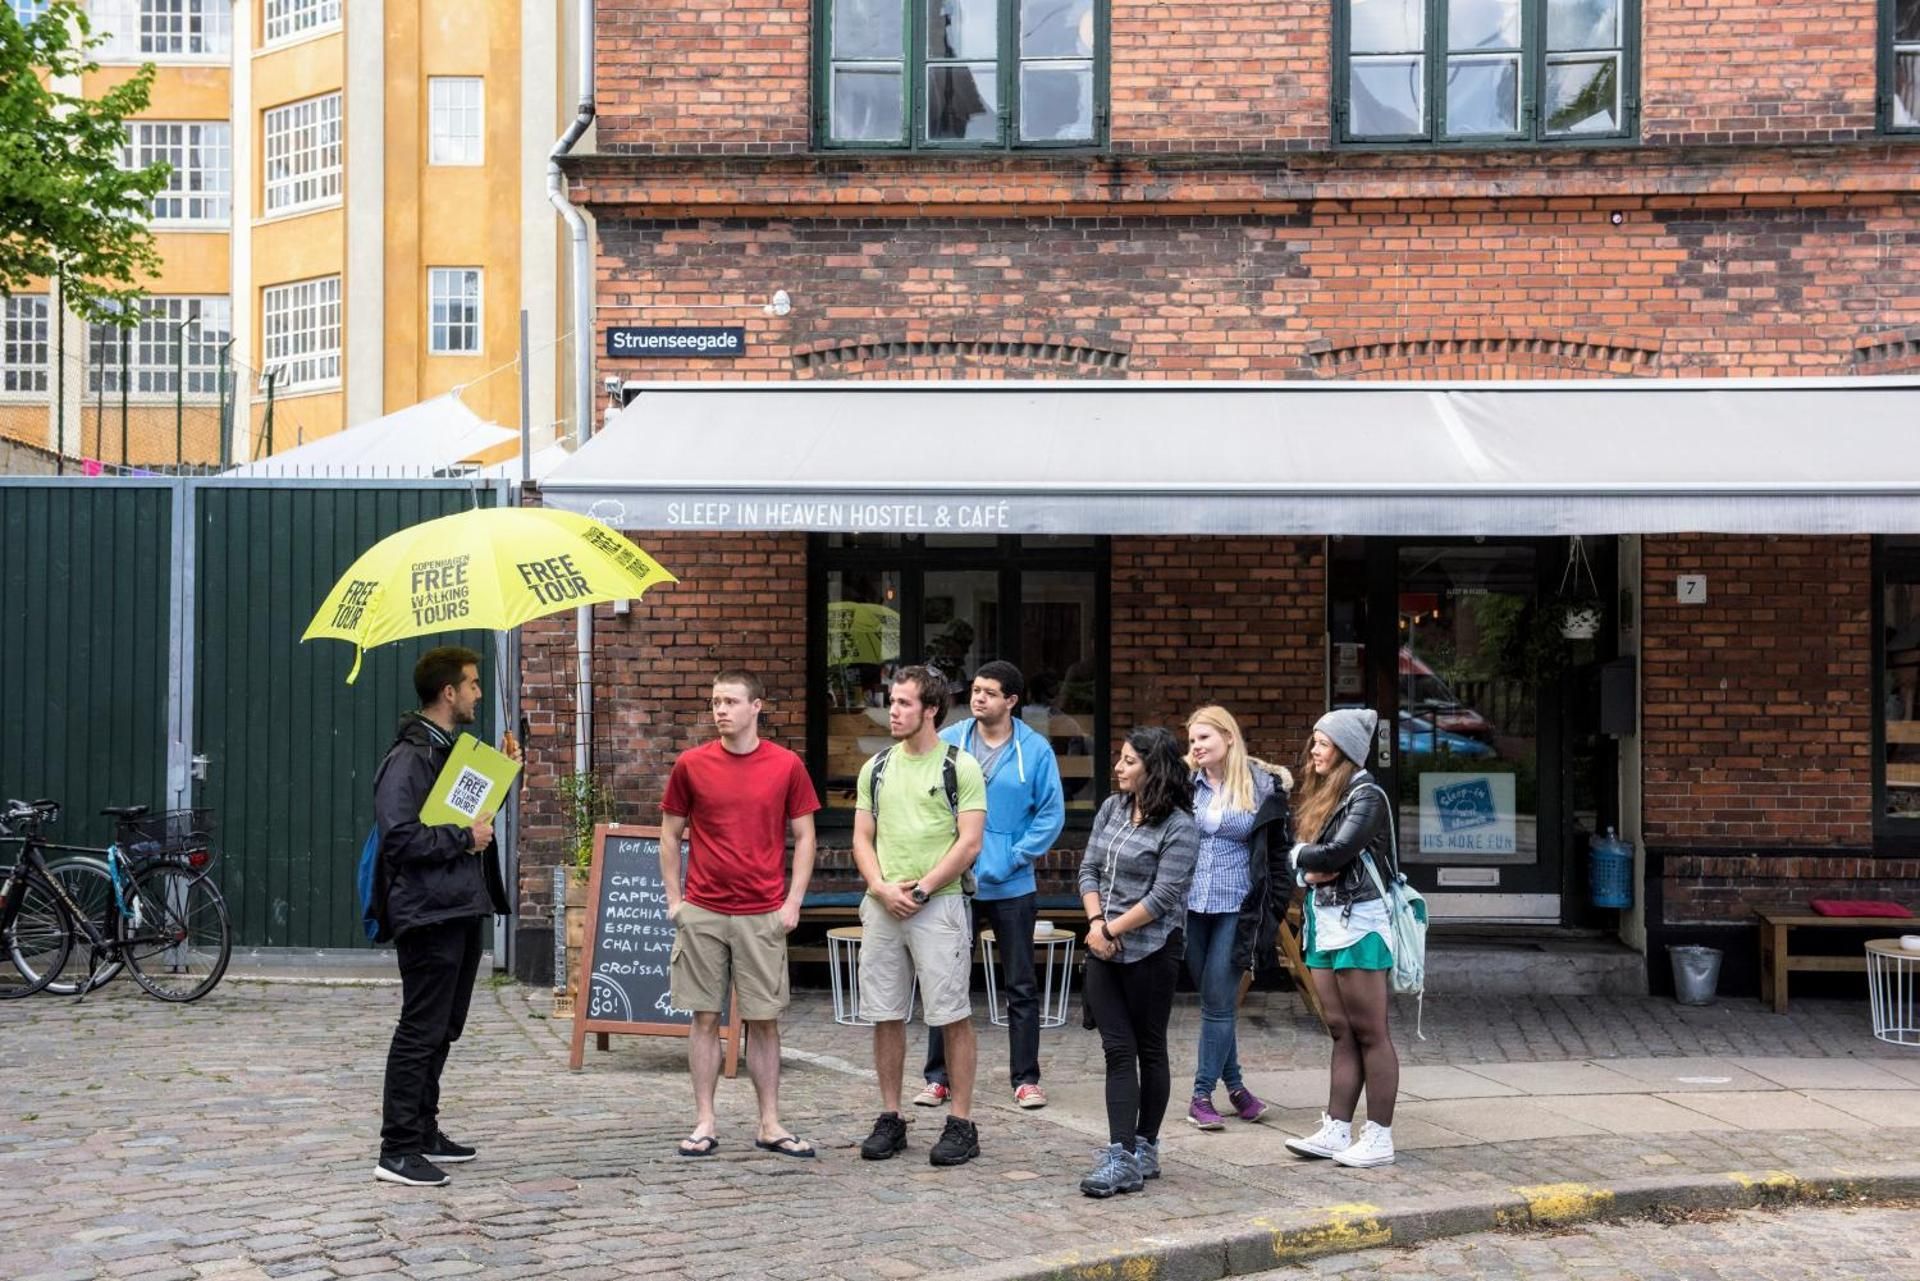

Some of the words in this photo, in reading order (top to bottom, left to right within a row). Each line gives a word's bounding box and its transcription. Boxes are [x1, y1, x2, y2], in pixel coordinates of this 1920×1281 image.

[613, 332, 738, 351] Struenseegade
[667, 502, 730, 525] SLEEP
[737, 503, 758, 525] IN
[765, 503, 842, 526] HEAVEN
[850, 504, 928, 527] HOSTEL
[935, 505, 952, 528] &
[958, 499, 1009, 528] CAFÉ
[411, 553, 470, 571] COPENHAGEN
[516, 554, 581, 585] FREE
[411, 563, 468, 594] FREE
[1686, 581, 1697, 594] 7
[341, 580, 379, 606] FREE
[528, 576, 593, 605] TOUR
[331, 603, 363, 630] TOUR
[412, 600, 469, 627] TOURS
[458, 775, 486, 798] FREE
[1448, 834, 1483, 849] MORE
[608, 891, 668, 904] CAPPUC
[606, 906, 670, 920] MACCHIAT
[605, 922, 677, 937] ESPRESSO
[602, 938, 638, 952] CHAI
[644, 941, 671, 952] LAT
[592, 986, 611, 998] TO
